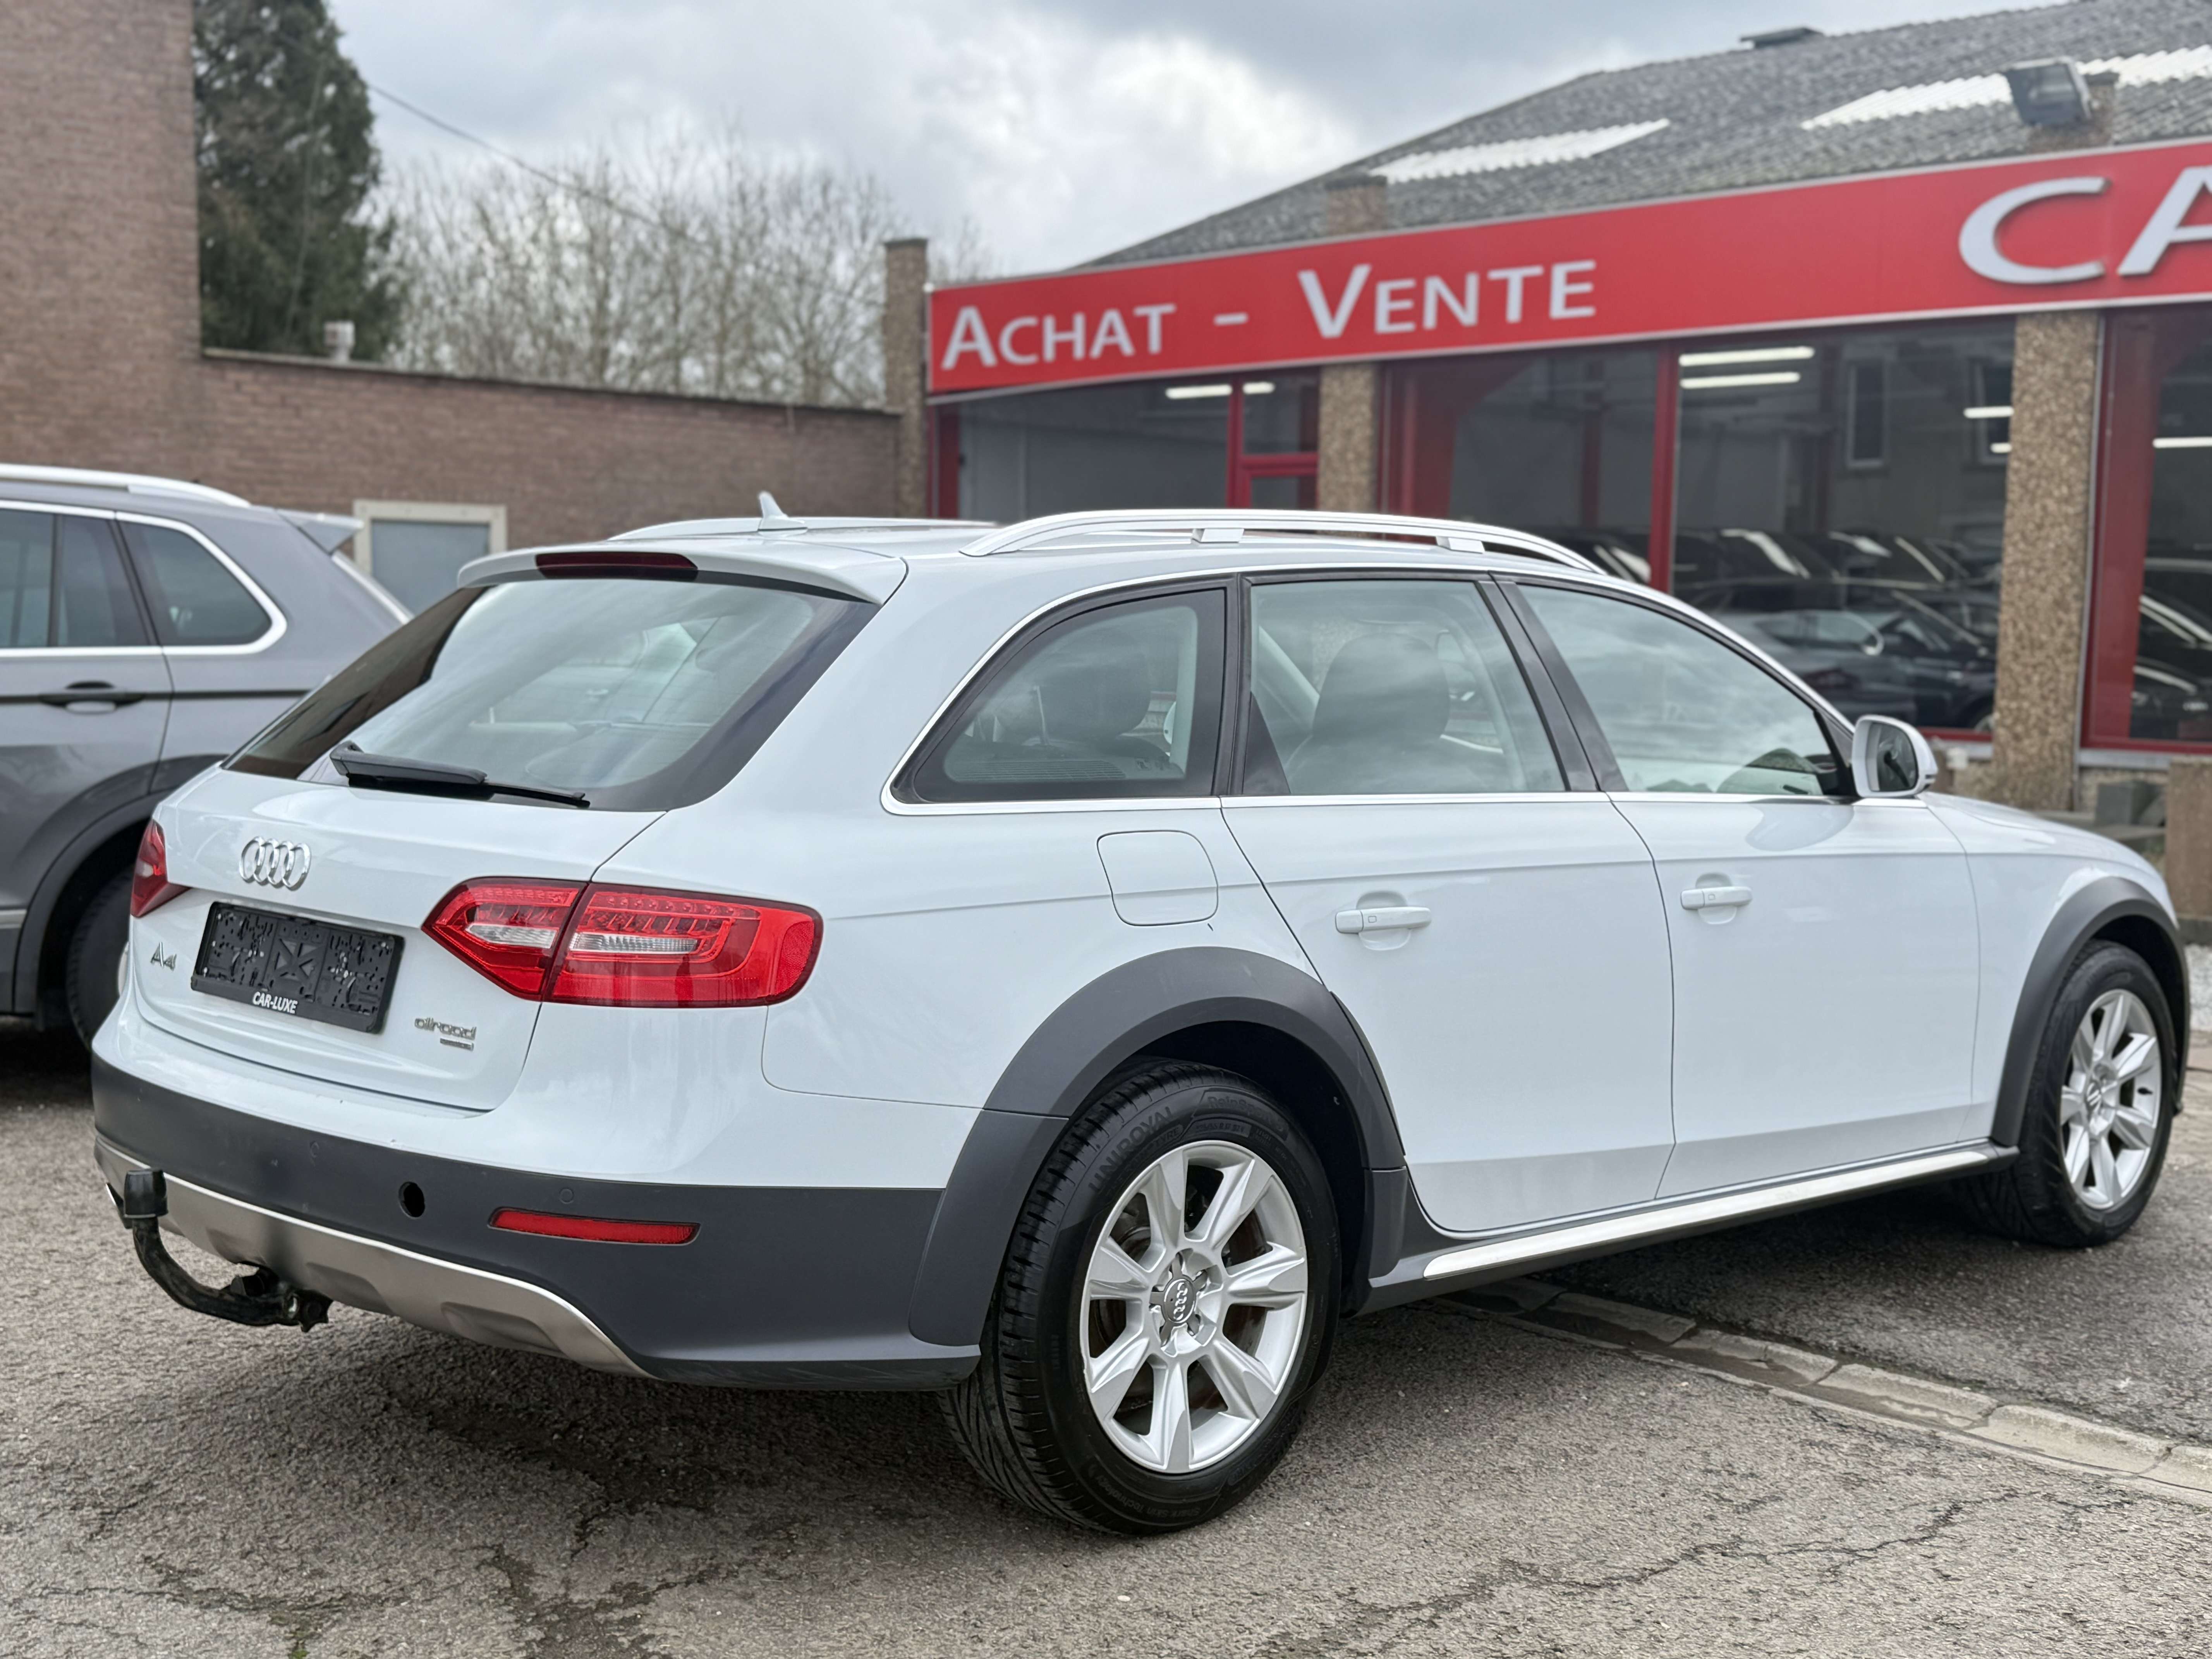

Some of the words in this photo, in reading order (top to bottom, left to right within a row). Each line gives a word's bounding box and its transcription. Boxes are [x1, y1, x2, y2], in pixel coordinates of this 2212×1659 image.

[941, 303, 1176, 370] ACHAT
[1297, 259, 1596, 339] VENTE
[150, 941, 177, 972] A4
[252, 991, 298, 1014] CAR-LUXE
